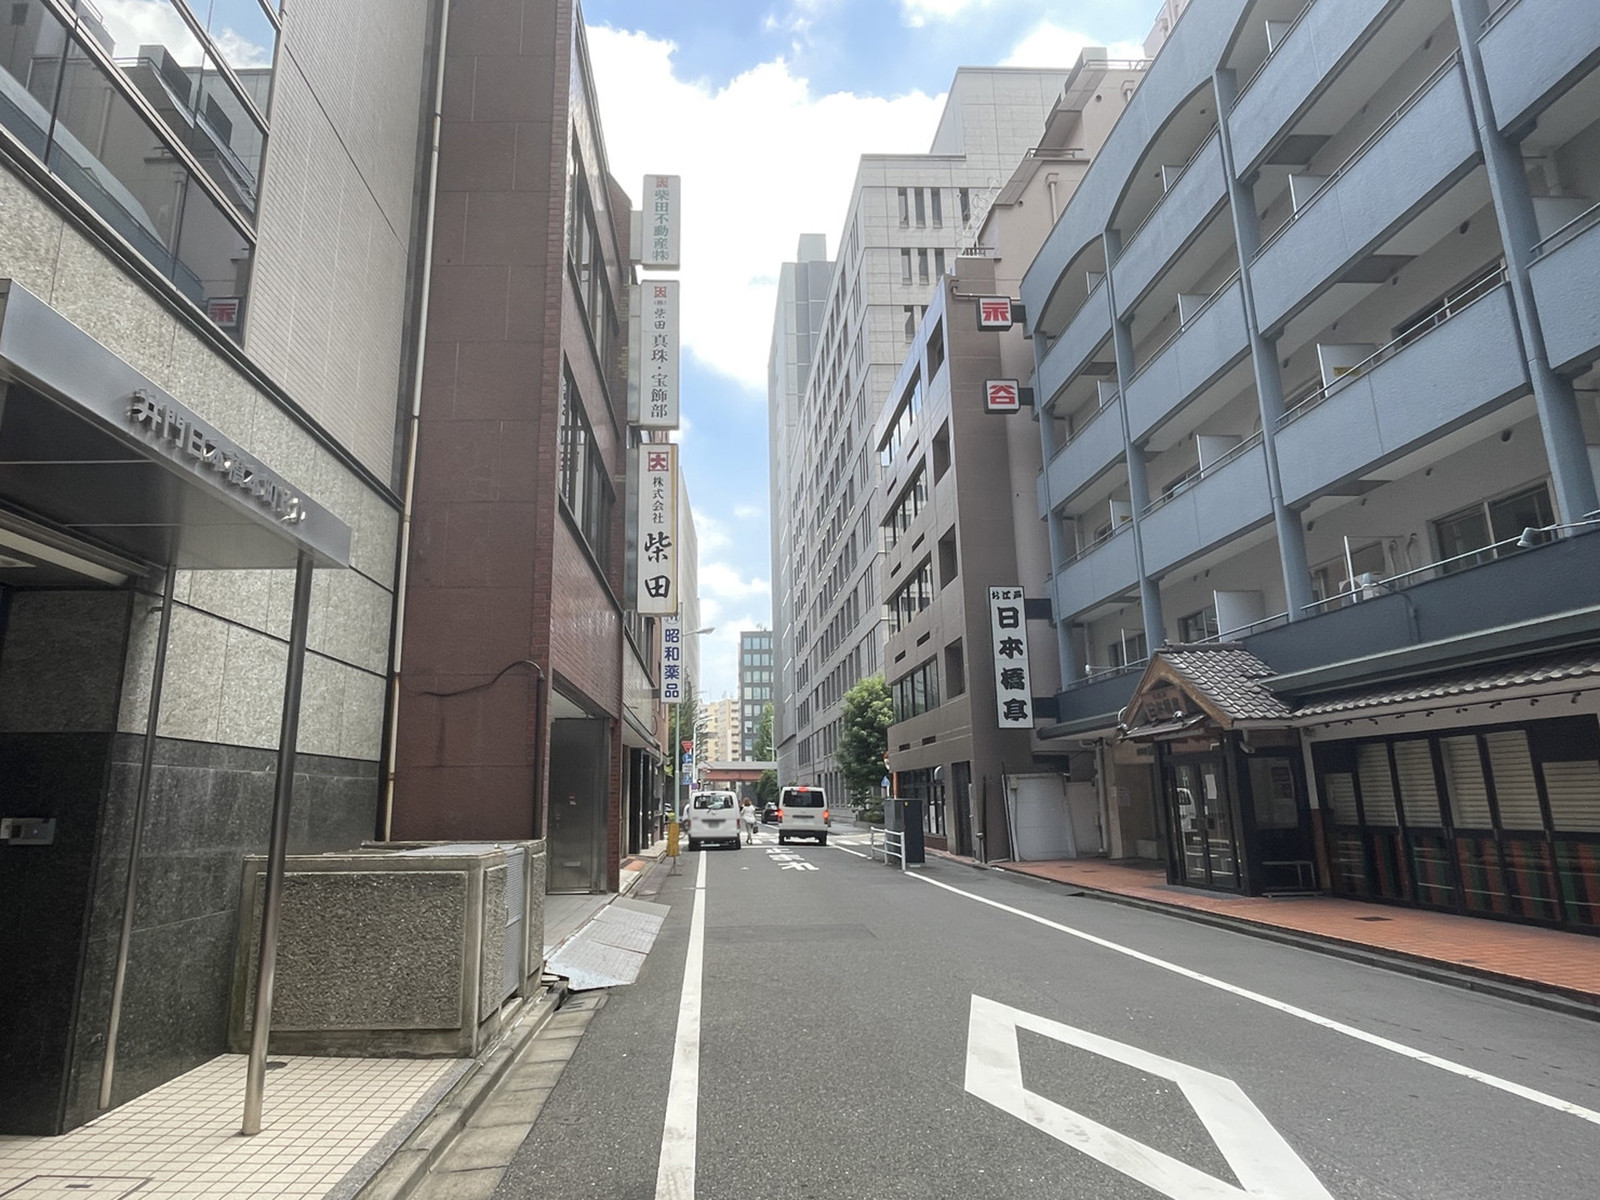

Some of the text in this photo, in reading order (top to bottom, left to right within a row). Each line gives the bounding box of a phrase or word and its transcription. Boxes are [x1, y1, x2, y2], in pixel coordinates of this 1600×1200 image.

[644, 477, 672, 599] 株式会社 柴田
[992, 590, 1022, 600] お江戸
[664, 629, 680, 698] 昭和薬品
[766, 847, 820, 871] 止まれ
